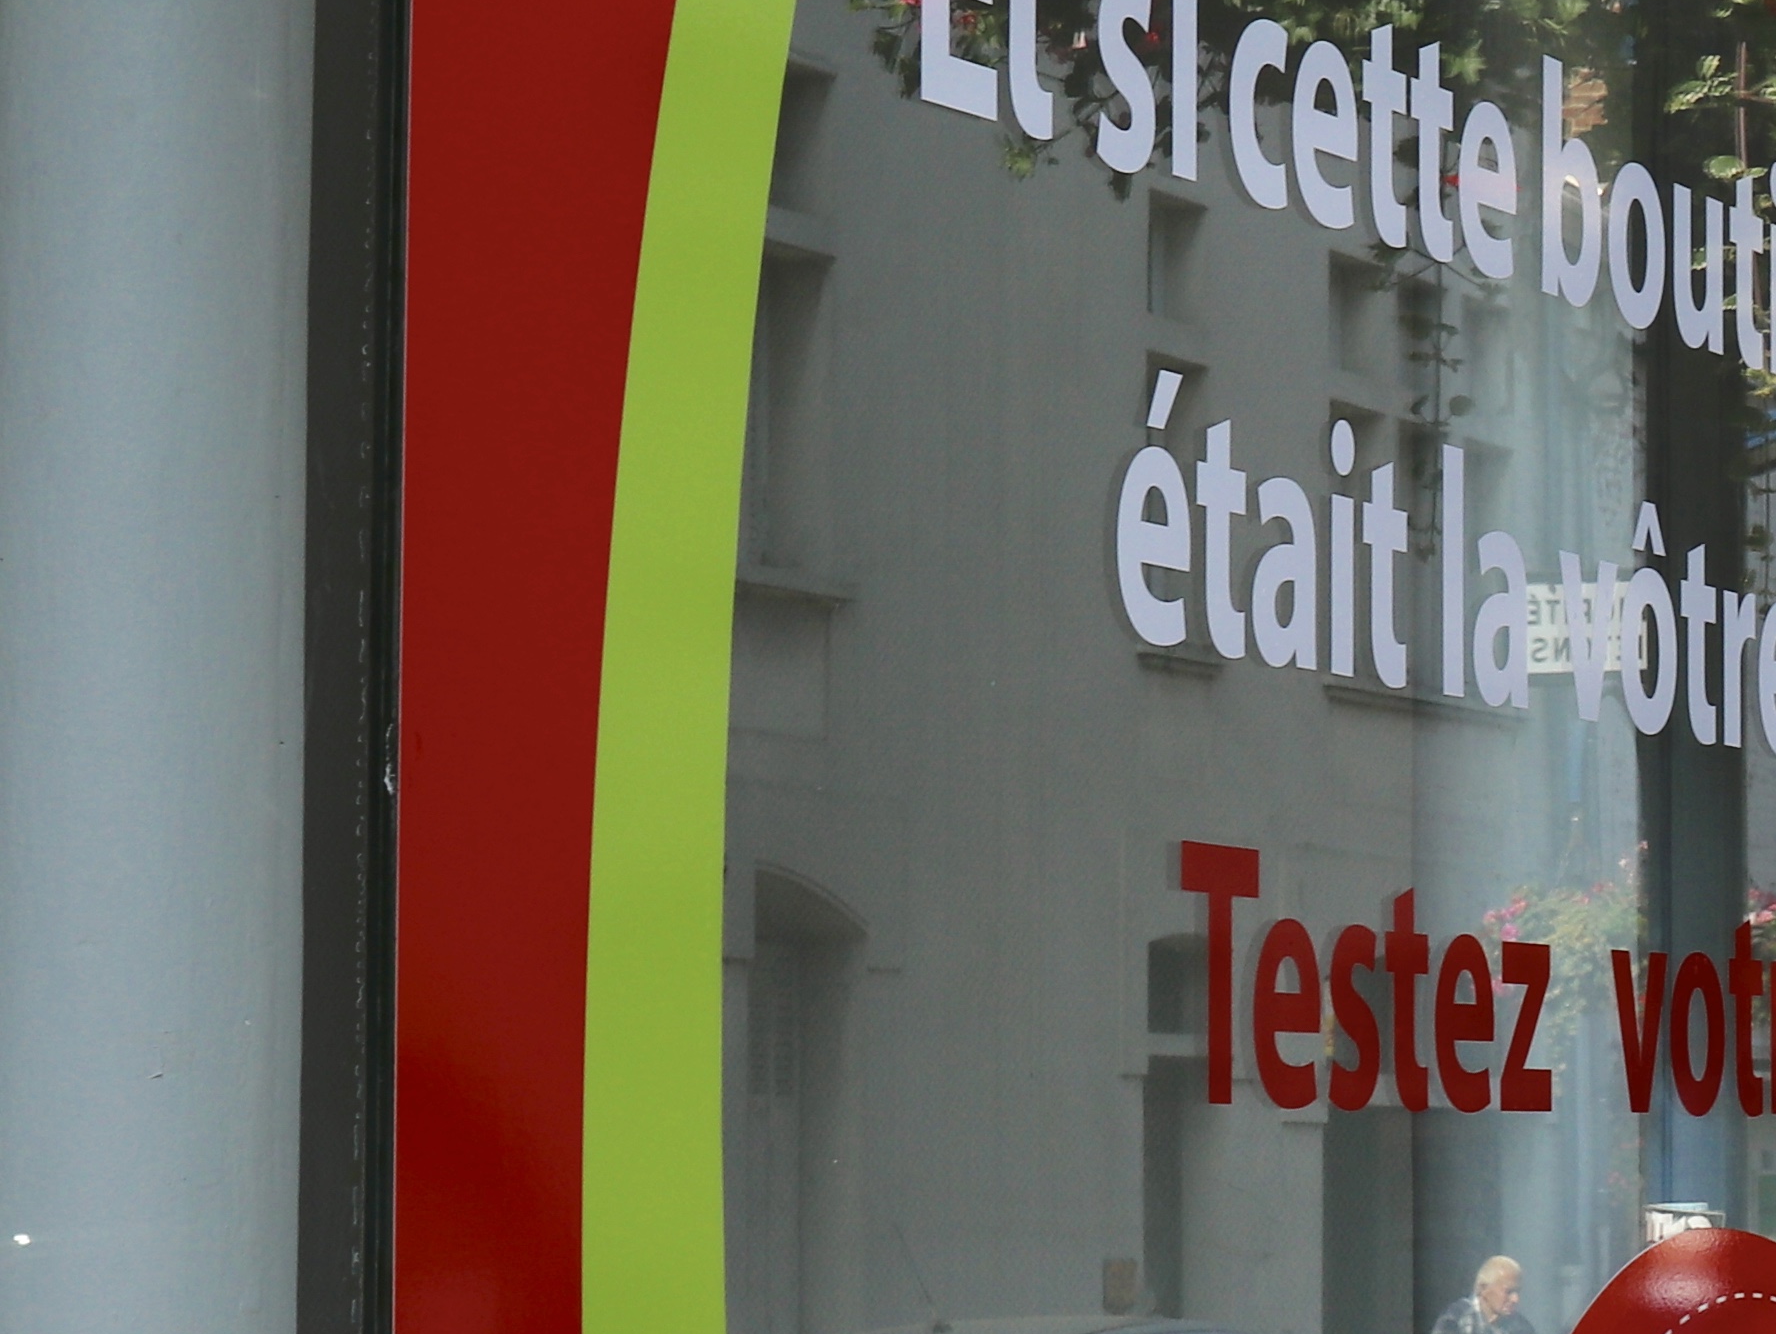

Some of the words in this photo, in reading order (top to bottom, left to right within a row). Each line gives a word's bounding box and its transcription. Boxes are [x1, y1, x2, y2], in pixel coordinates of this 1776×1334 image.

[1228, 18, 1517, 278] cette
[1116, 369, 1408, 690] était
[1442, 448, 1530, 710] la
[1180, 840, 1552, 1113] Testez
